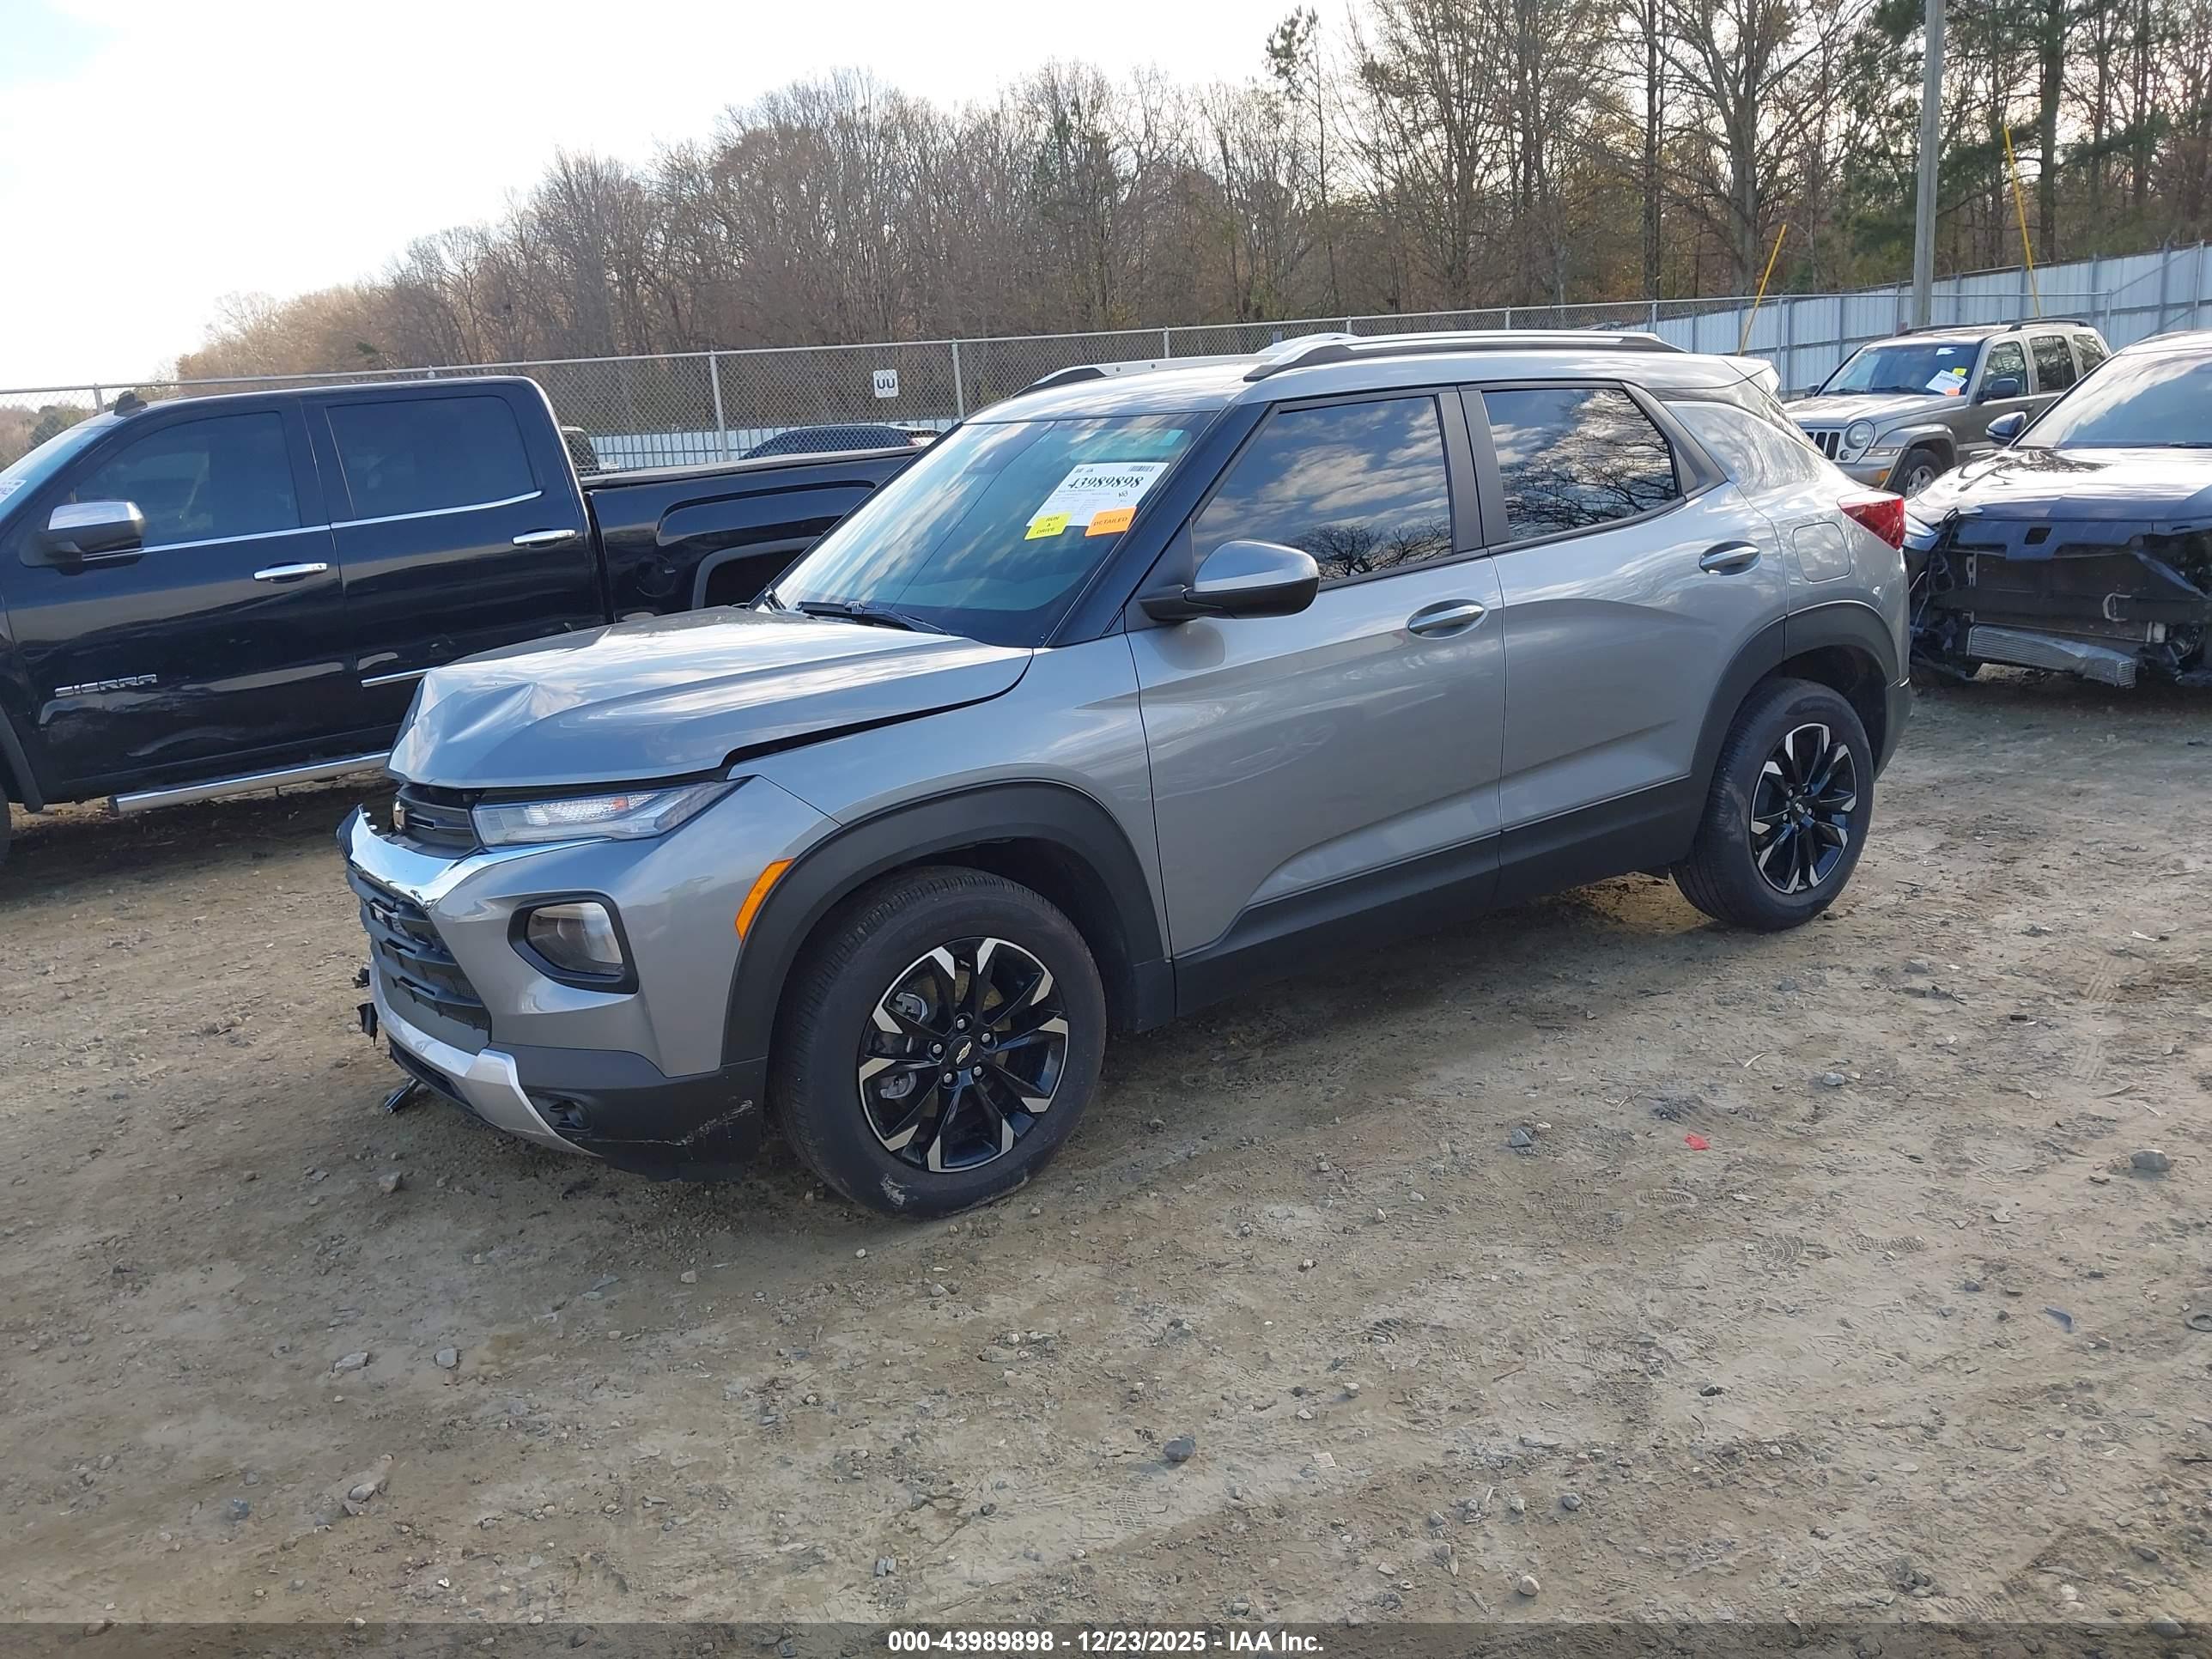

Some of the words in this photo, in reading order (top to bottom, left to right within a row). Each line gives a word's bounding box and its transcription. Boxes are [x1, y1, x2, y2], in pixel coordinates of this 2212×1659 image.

[877, 378, 896, 389] UU
[1068, 476, 1144, 489] 43989898
[1093, 517, 1127, 526] DETAILED
[54, 674, 158, 697] SIERRA
